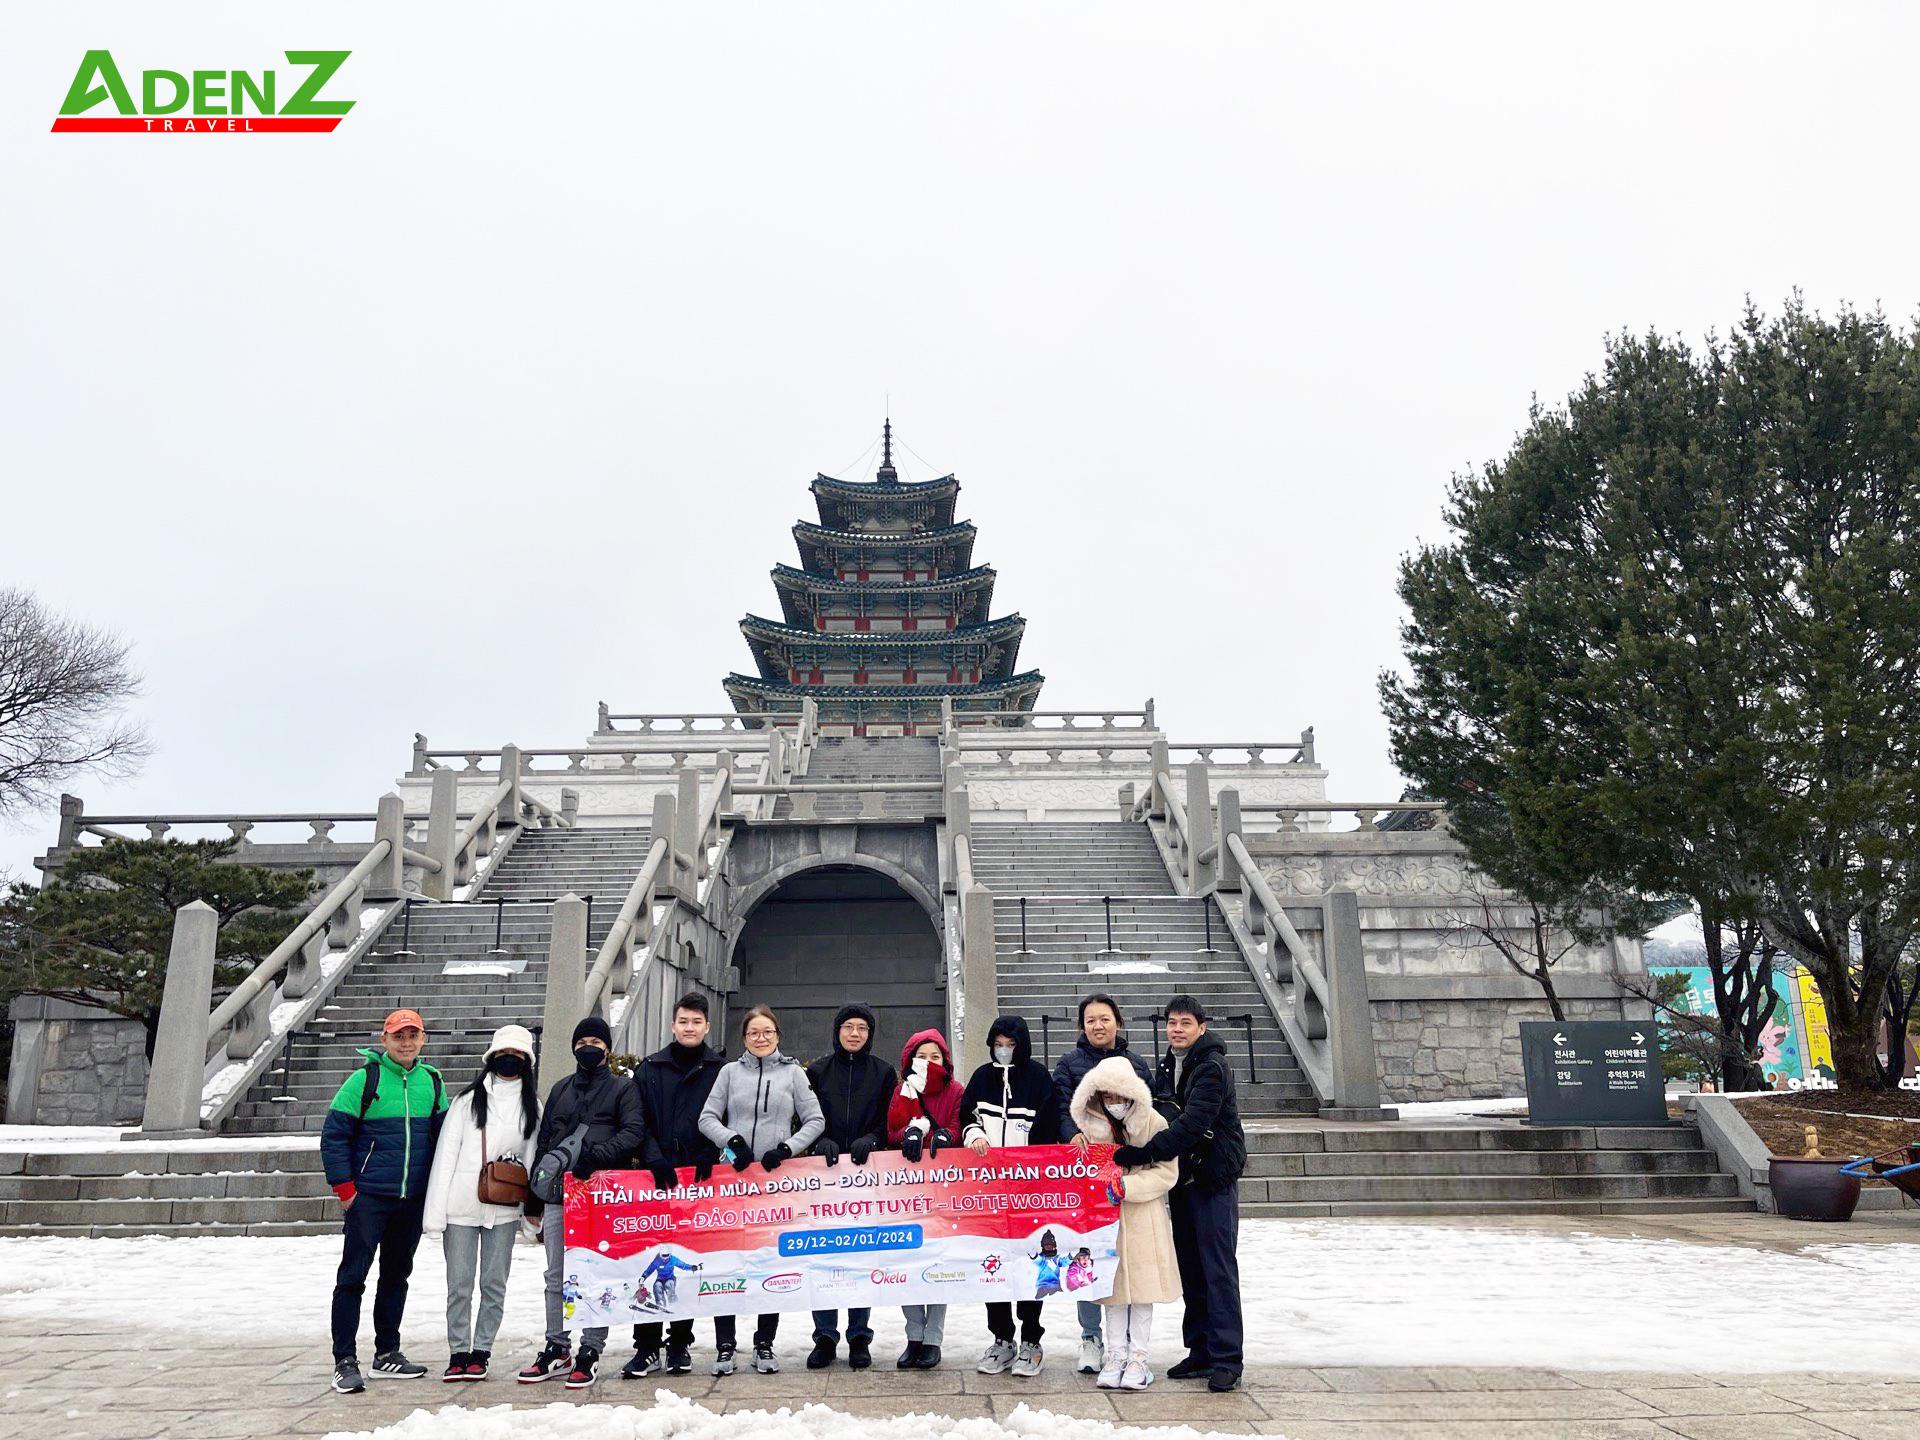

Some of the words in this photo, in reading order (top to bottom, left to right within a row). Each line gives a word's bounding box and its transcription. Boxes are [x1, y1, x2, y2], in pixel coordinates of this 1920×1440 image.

[1554, 1050, 1576, 1059] 전시관
[1604, 1049, 1647, 1058] 어린이박물관
[1557, 1071, 1571, 1080] 강당
[1608, 1070, 1629, 1079] 추억의
[1631, 1070, 1646, 1079] 거리
[590, 1185, 633, 1205] TRẢI
[639, 1184, 714, 1202] NGHIỆM
[719, 1179, 761, 1198] MÙA
[764, 1175, 821, 1194] ĐÔNG
[838, 1170, 879, 1189] ĐÓN
[884, 1168, 925, 1186] NĂM
[929, 1165, 964, 1183] MỚI
[968, 1166, 997, 1184] TẠI
[1001, 1163, 1040, 1180] HÀN
[1044, 1157, 1100, 1179] QUỐC
[613, 1214, 677, 1234] SEOUL
[694, 1207, 738, 1229] ĐẢO
[741, 1205, 794, 1225] NAMI
[810, 1198, 874, 1219] TRƯỢT
[876, 1193, 935, 1215] TUYẾT
[951, 1193, 1008, 1211] LOTTE
[1010, 1192, 1082, 1210] WORLD
[787, 1231, 914, 1251] 29/12-02/01/2024
[870, 1269, 907, 1284] Okela
